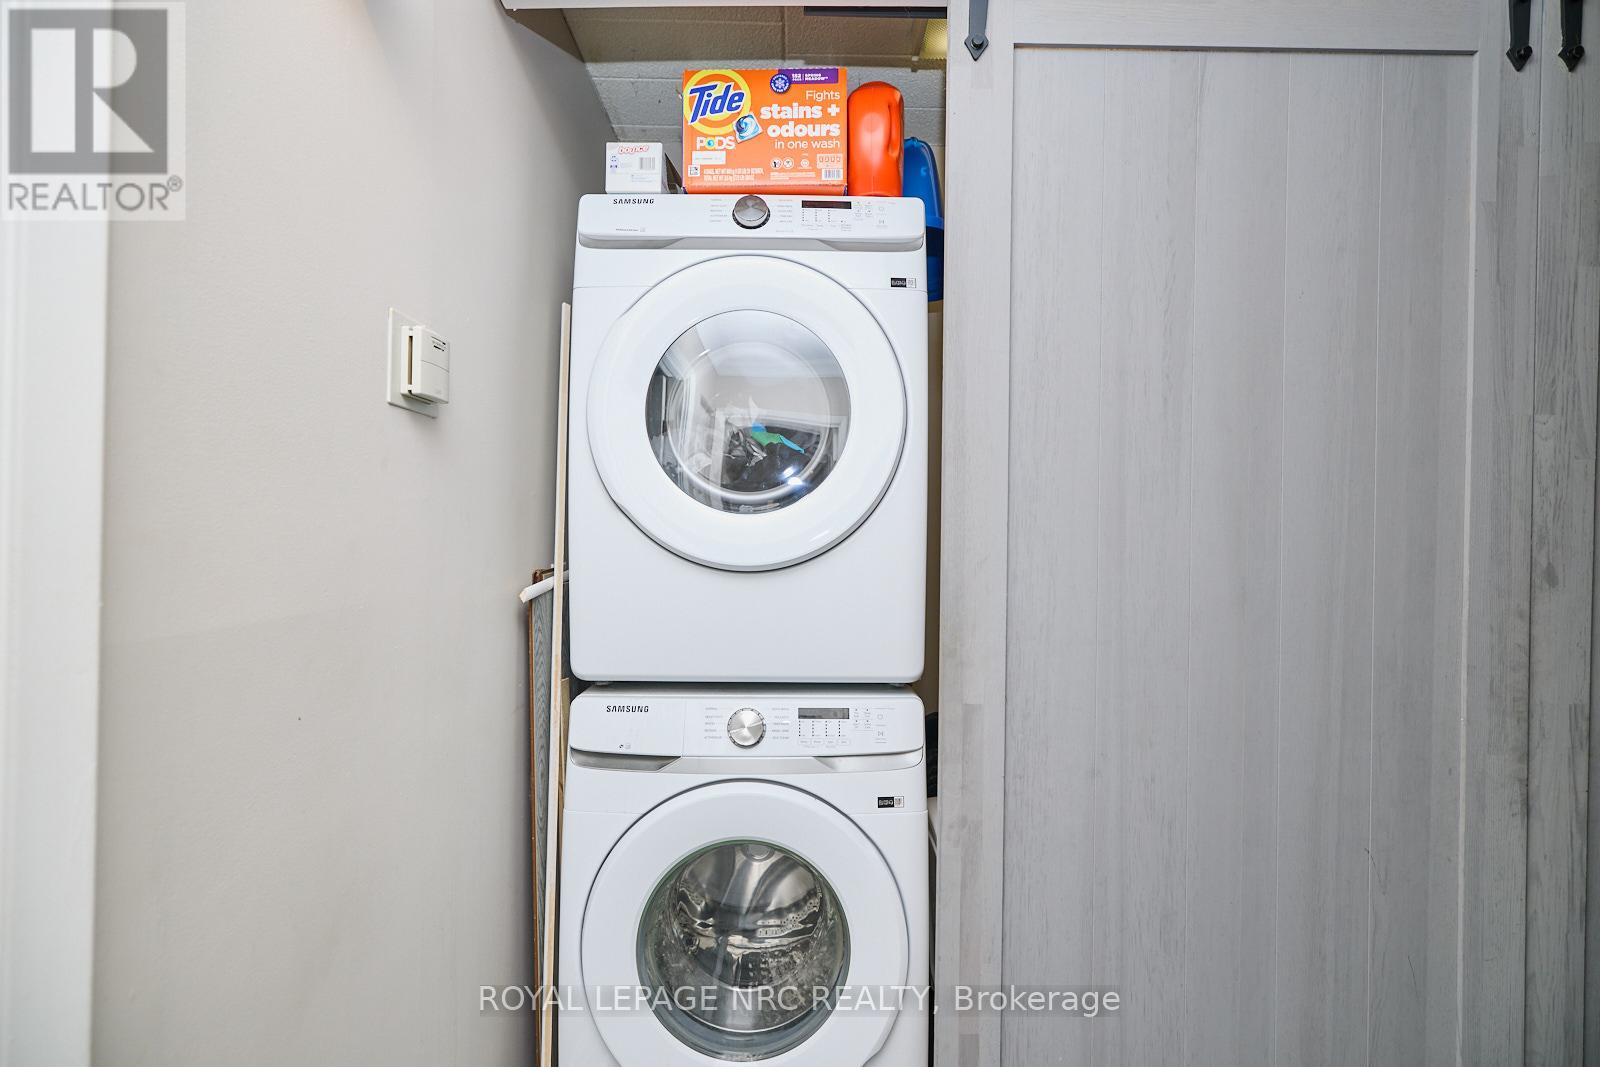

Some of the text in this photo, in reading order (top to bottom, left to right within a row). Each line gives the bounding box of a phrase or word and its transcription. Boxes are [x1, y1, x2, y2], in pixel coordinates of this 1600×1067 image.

[805, 90, 840, 102] Fights
[688, 83, 745, 124] Tide
[760, 102, 823, 119] stains
[767, 121, 840, 138] odours
[696, 136, 736, 150] PODS
[774, 138, 840, 149] in one wash
[606, 705, 649, 713] SAMSUNG
